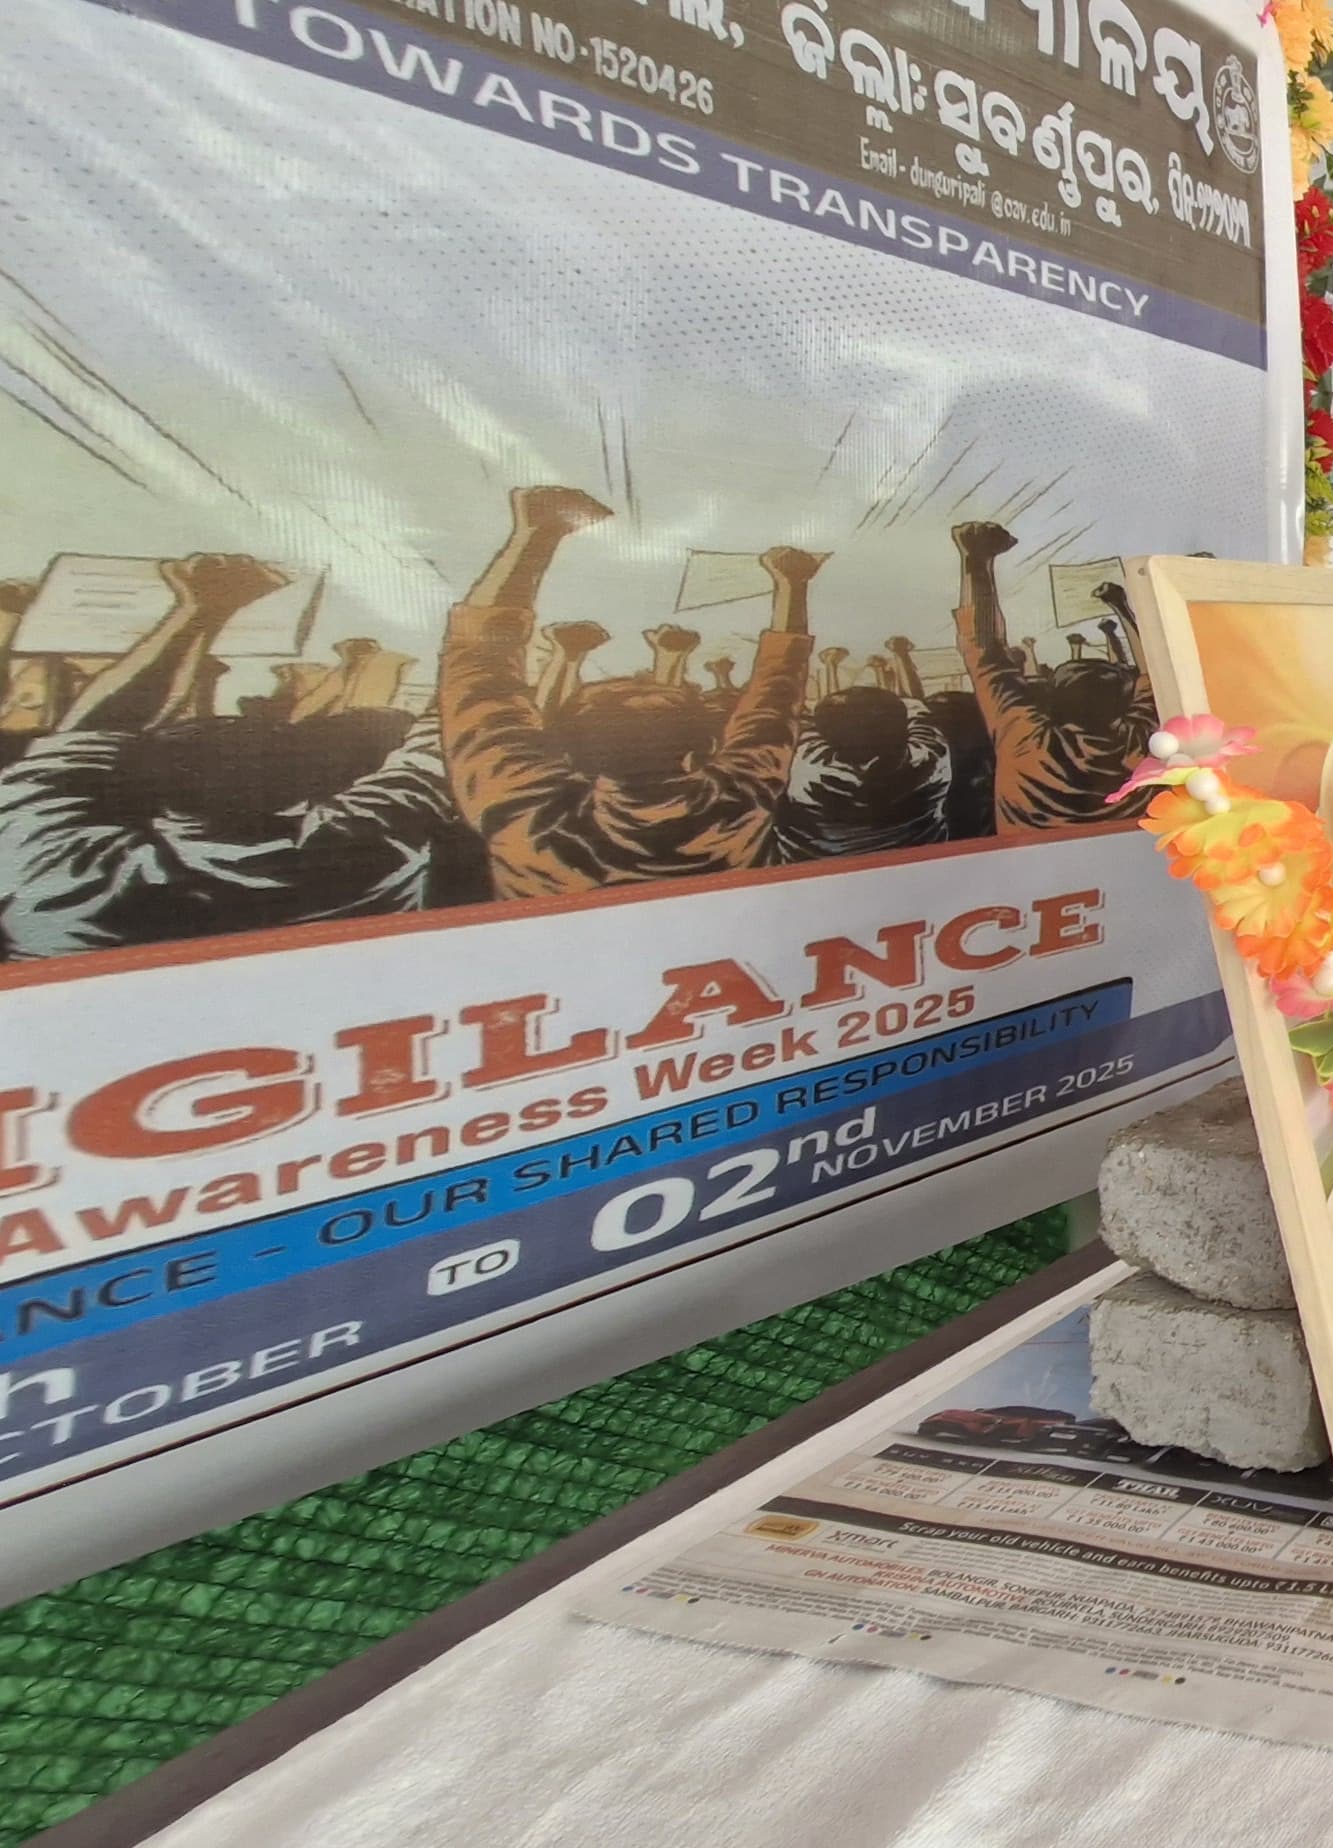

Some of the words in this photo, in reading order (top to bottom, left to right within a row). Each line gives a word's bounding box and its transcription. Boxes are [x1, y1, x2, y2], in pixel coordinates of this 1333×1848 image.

[910, 156, 986, 209] dunguripali
[720, 153, 1149, 316] TRANSPARENCY
[0, 1085, 608, 1266] Awareness
[634, 1026, 820, 1100] Week
[837, 986, 975, 1049] 2025
[811, 1082, 1047, 1183] NOVEMBER
[1057, 1053, 1136, 1097] 2025
[0, 1250, 218, 1342] NCE
[318, 1176, 488, 1248] OUR
[514, 1100, 758, 1191] SHARED
[777, 1000, 1100, 1114] RESPONSIBILITY
[436, 1249, 510, 1287] TO
[1113, 1480, 1180, 1499] THAR
[895, 1521, 951, 1536] Scrap
[943, 1529, 989, 1542] your
[986, 1533, 1021, 1545] old
[1016, 1538, 1084, 1555] vehicle
[1078, 1550, 1118, 1563] and
[1114, 1558, 1158, 1570] earn
[1156, 1563, 1230, 1583] benefits
[1226, 1575, 1272, 1591] upto
